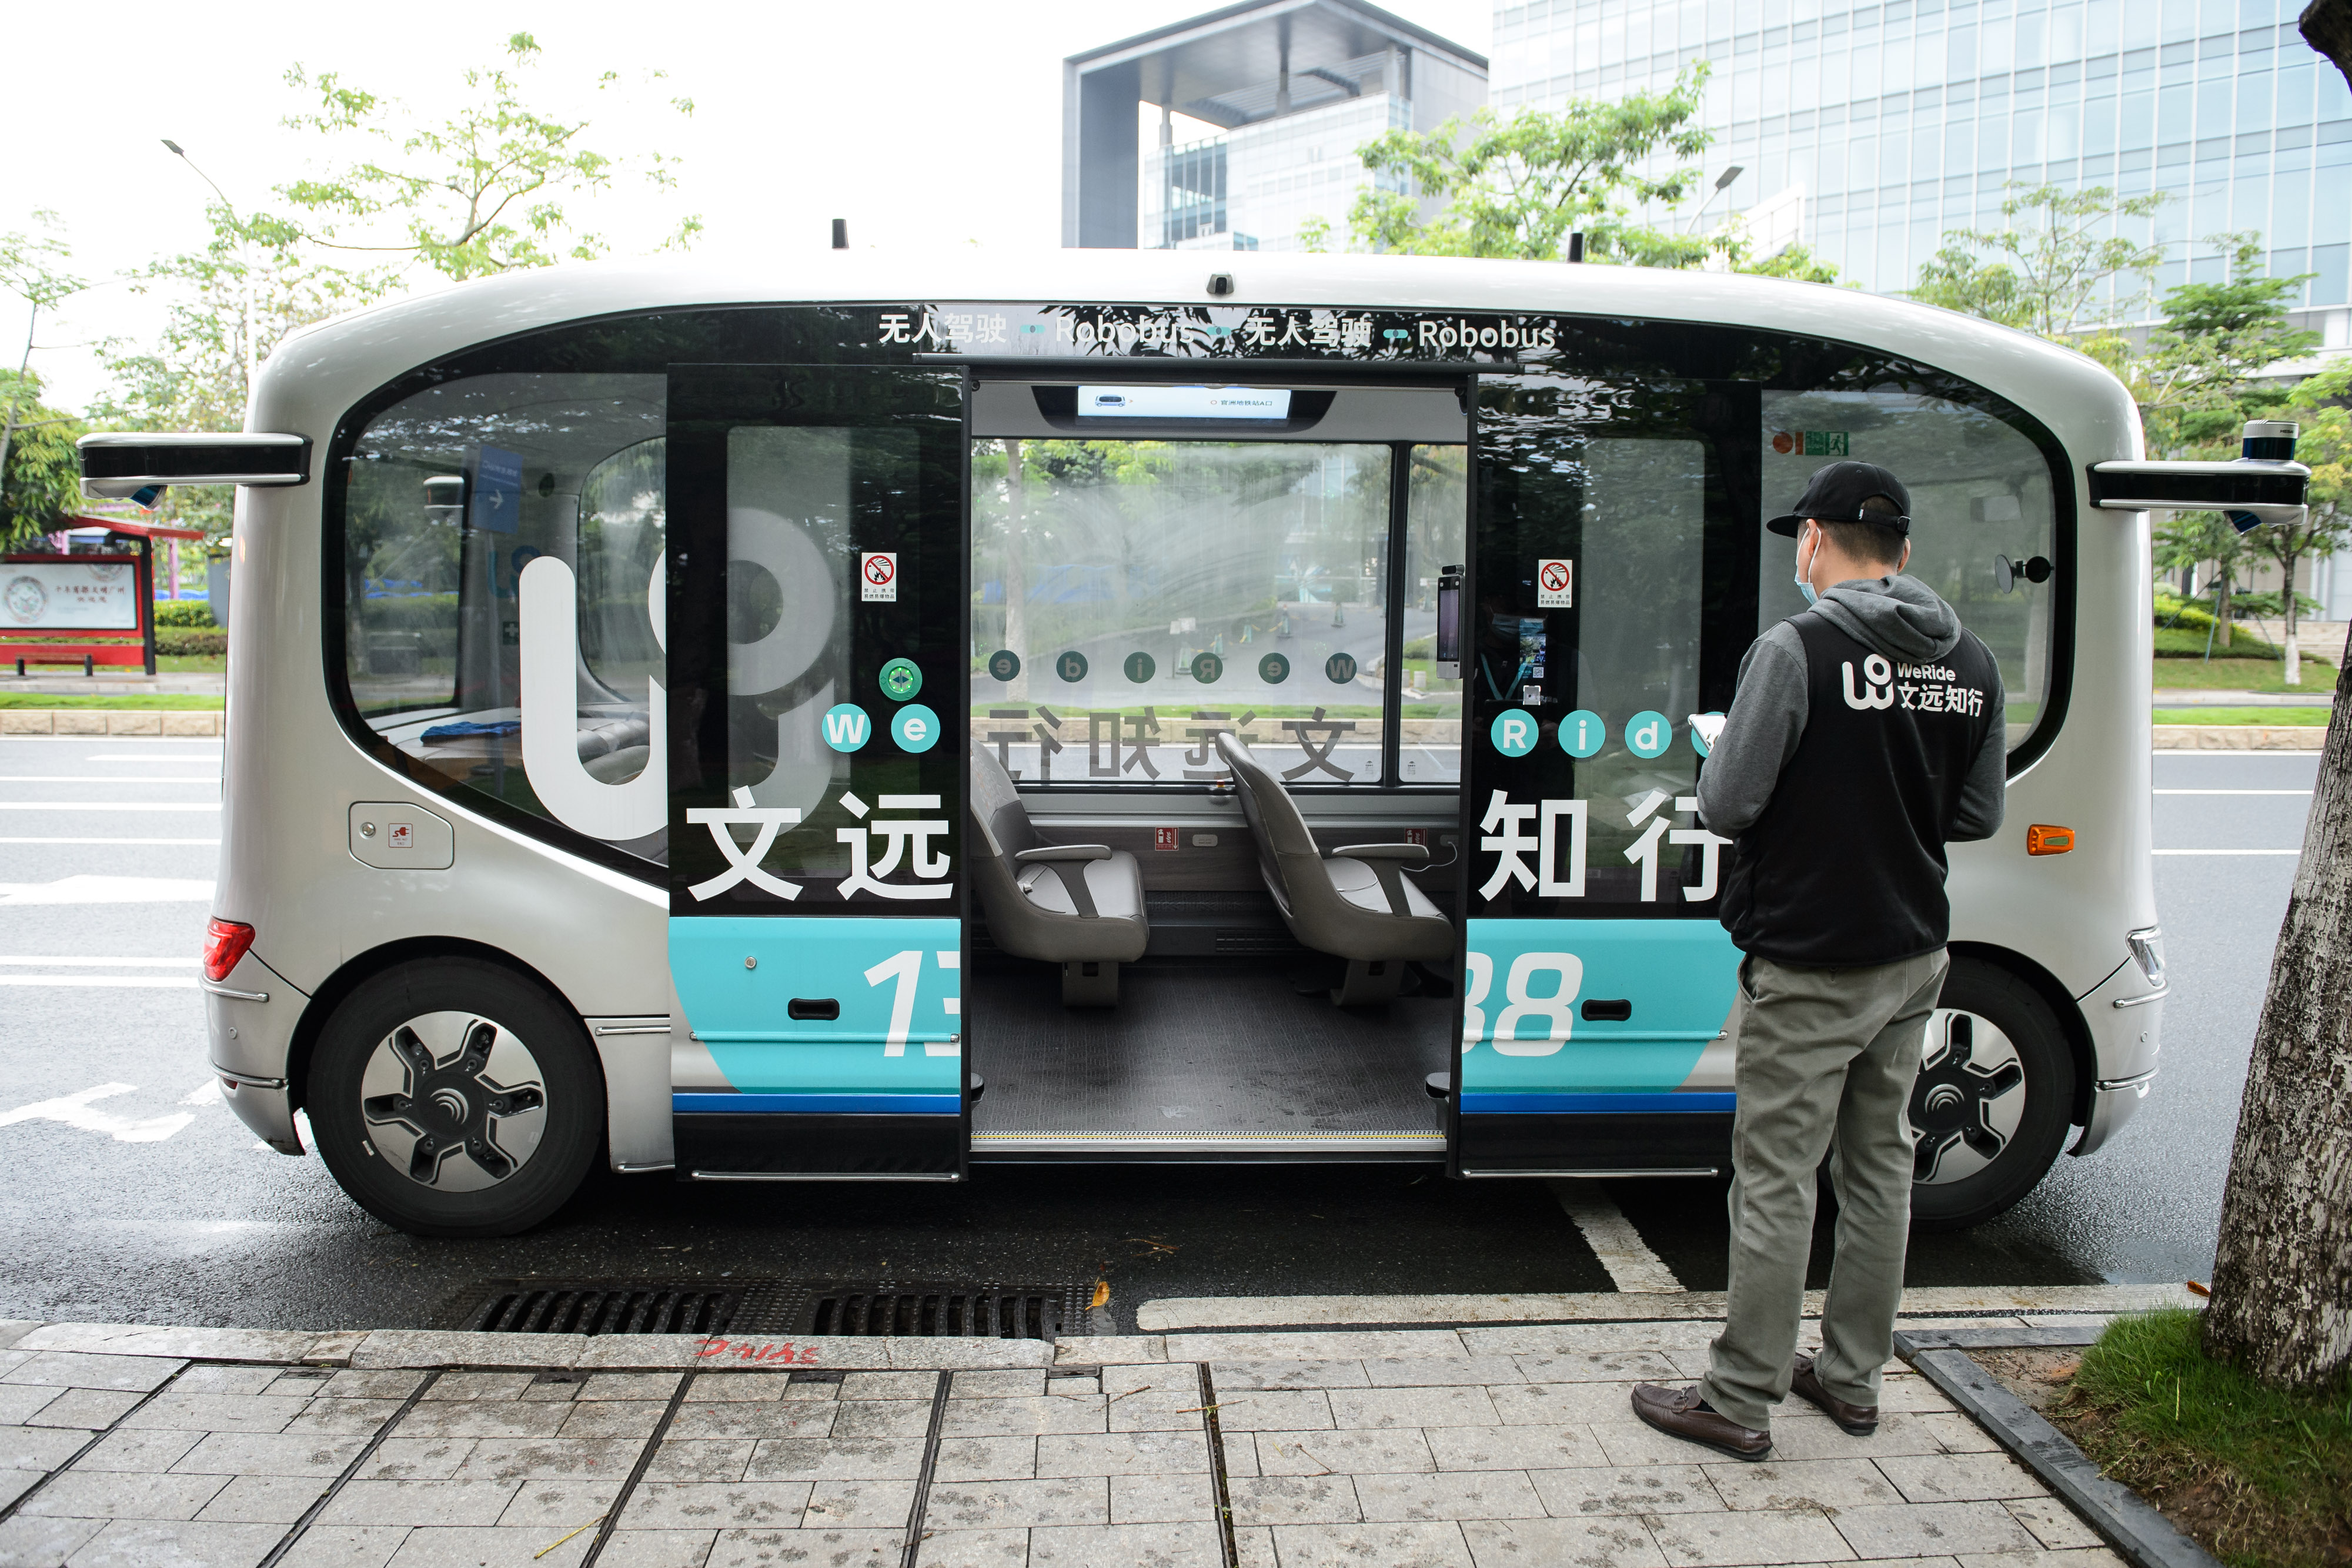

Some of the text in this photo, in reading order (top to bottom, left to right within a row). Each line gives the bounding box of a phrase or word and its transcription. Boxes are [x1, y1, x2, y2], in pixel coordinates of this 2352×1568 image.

[879, 313, 1556, 349] 无人驾驶 Robobus 无人驾驶 Robobus
[1897, 663, 1956, 681] WeRide
[1897, 681, 1983, 717] 文远知行
[686, 785, 953, 902] 文远
[1479, 789, 1733, 902] 知行
